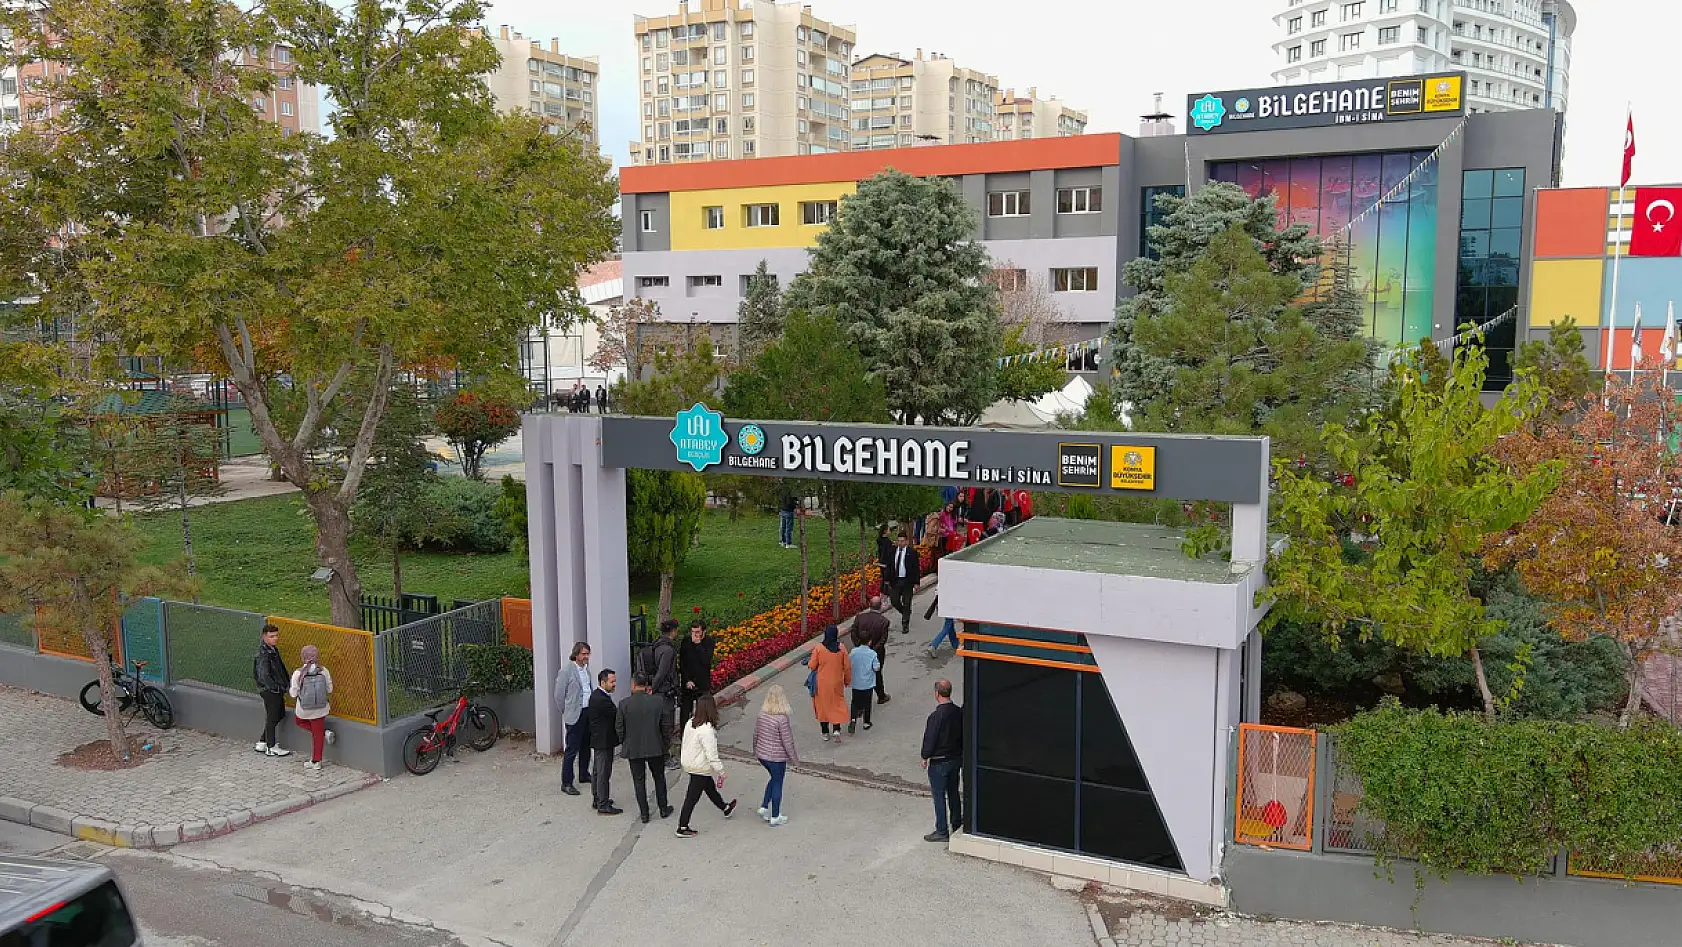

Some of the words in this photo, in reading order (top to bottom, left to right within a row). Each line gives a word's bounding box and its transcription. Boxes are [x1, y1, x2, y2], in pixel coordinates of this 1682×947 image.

[1258, 86, 1385, 118] BİLGEHANE
[728, 455, 777, 469] BİLGEHANE
[781, 434, 969, 480] BİLGEHANE
[975, 464, 1012, 483] İBN-İ
[1017, 466, 1051, 484] SİNA
[1061, 455, 1097, 466] BENİM
[1061, 465, 1097, 476] ŞEHRİM
